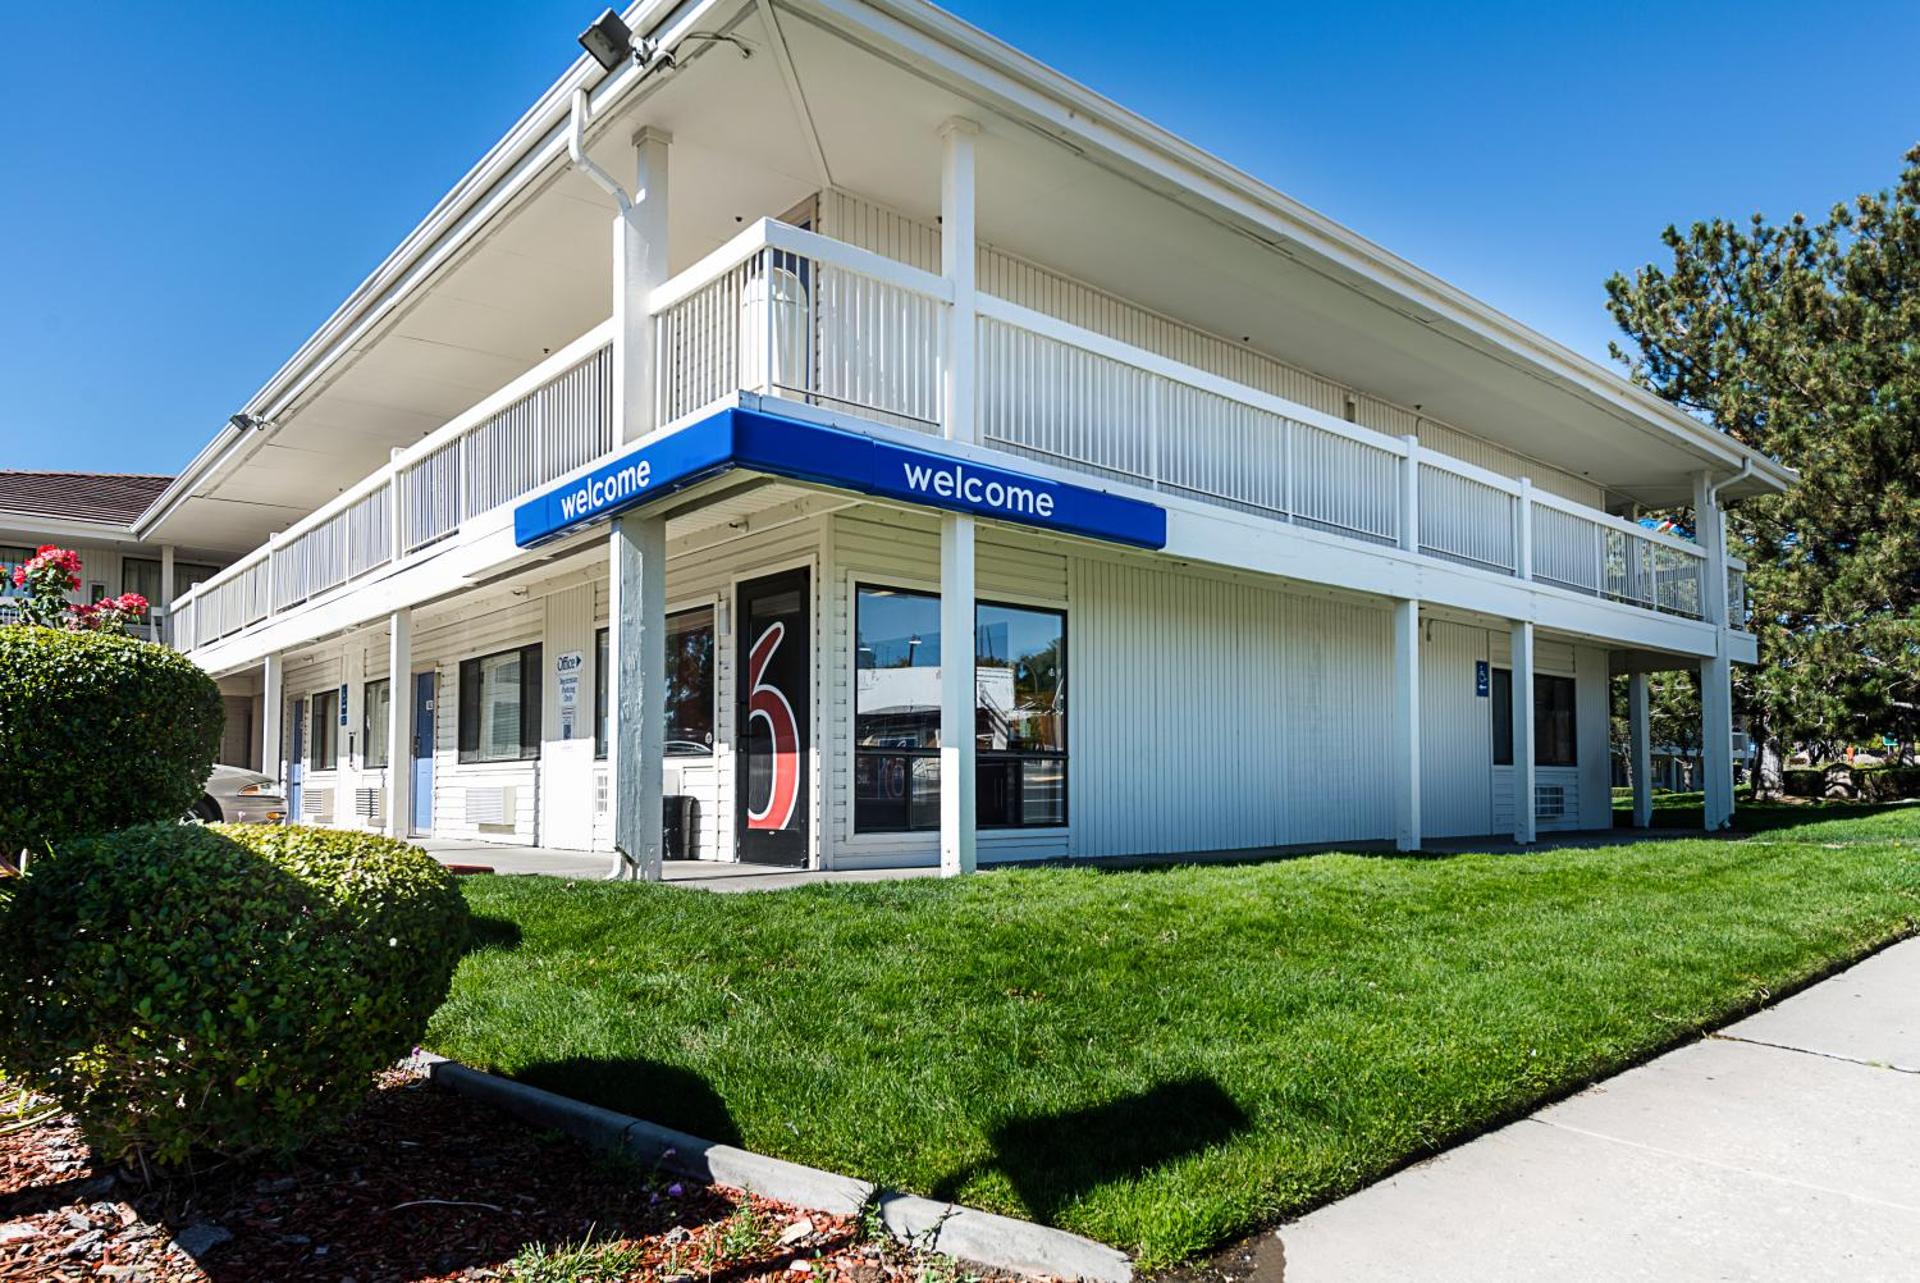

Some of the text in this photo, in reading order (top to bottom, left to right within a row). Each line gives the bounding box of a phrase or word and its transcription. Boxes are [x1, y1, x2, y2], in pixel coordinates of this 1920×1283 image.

[561, 460, 651, 520] welcome
[903, 462, 1055, 517] welcome
[557, 655, 576, 672] Office
